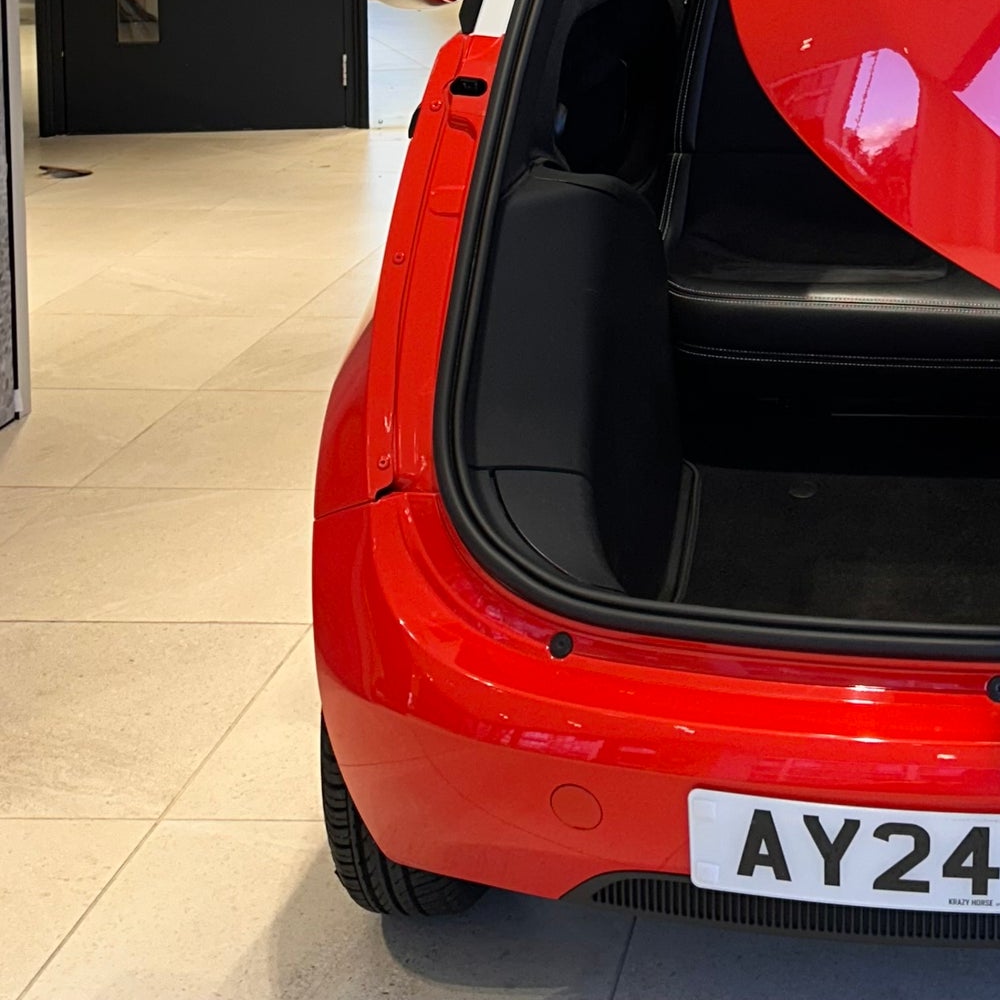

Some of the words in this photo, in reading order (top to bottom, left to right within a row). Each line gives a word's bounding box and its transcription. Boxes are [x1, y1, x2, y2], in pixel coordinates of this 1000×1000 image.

[737, 809, 1000, 896] AY24
[948, 898, 970, 906] KRAZY
[971, 898, 993, 907] HORSE
